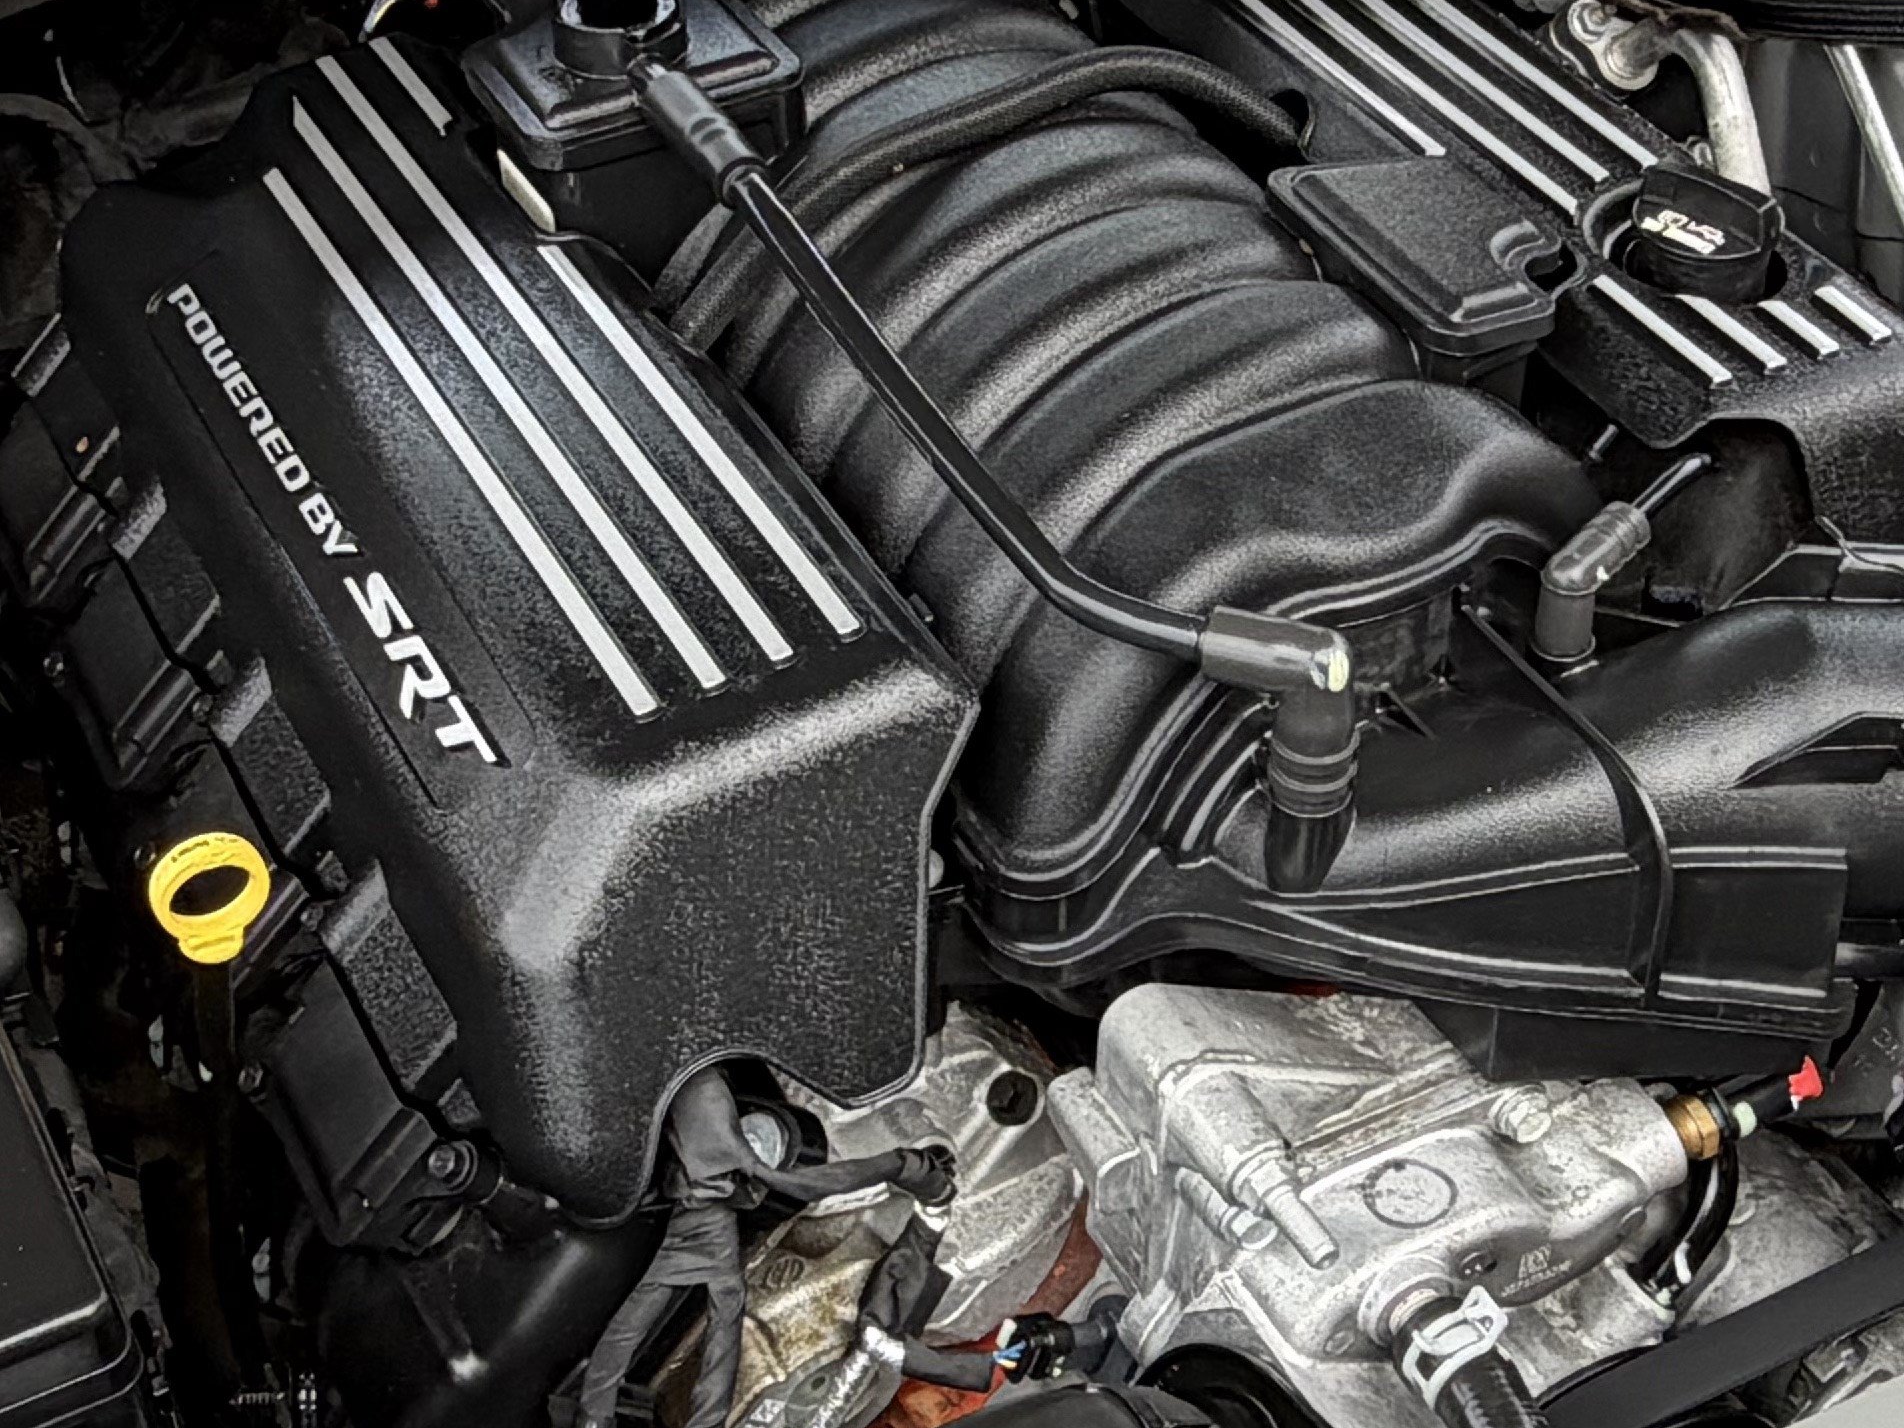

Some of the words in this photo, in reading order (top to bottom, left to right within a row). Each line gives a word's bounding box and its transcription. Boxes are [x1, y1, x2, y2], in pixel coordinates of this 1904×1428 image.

[167, 284, 315, 494] POWERED
[298, 494, 358, 556] BY
[344, 571, 500, 765] SRT
